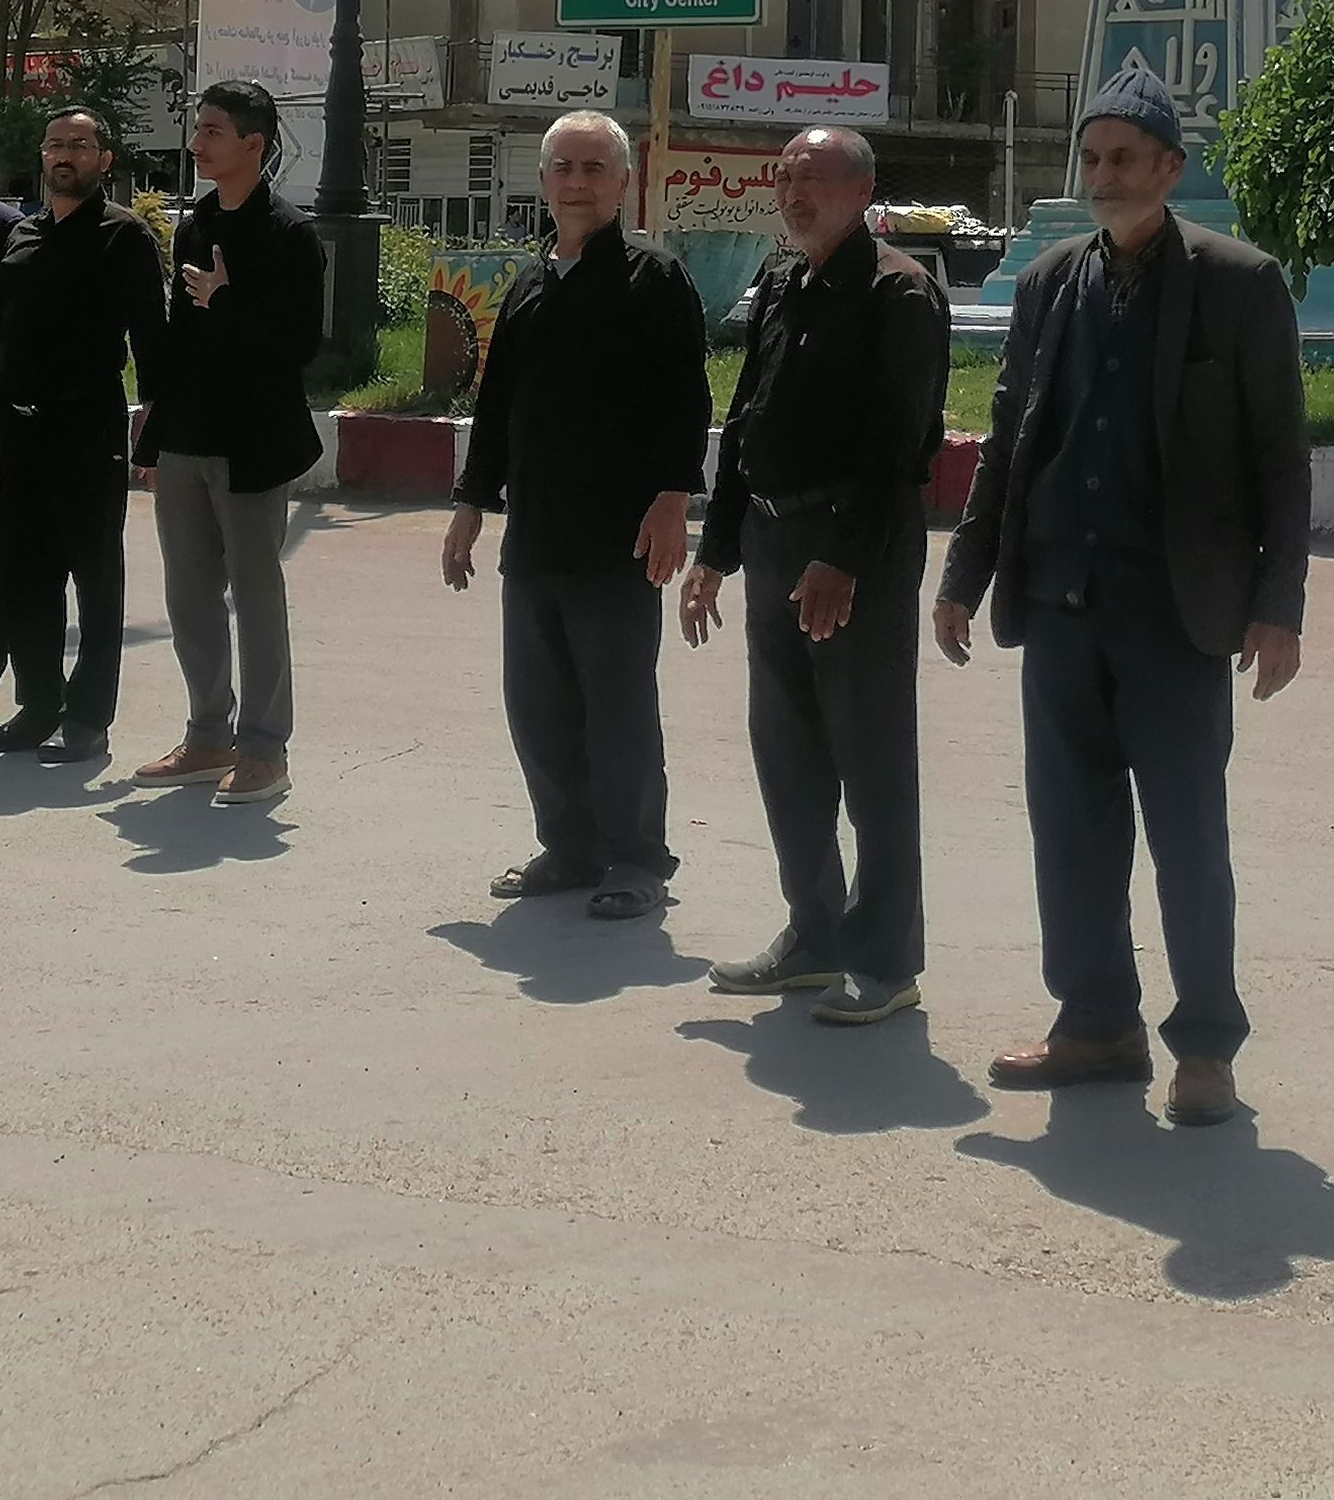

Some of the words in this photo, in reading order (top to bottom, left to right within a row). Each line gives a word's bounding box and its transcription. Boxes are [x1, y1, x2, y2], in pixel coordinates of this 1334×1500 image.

[499, 40, 557, 64] خشکبار
[558, 52, 565, 66] و
[567, 40, 615, 71] برنج
[499, 75, 554, 101] قدیمی
[557, 79, 609, 103] حاجی
[701, 60, 765, 99] داغ
[776, 68, 881, 104] حلیم
[665, 156, 723, 202] فوم
